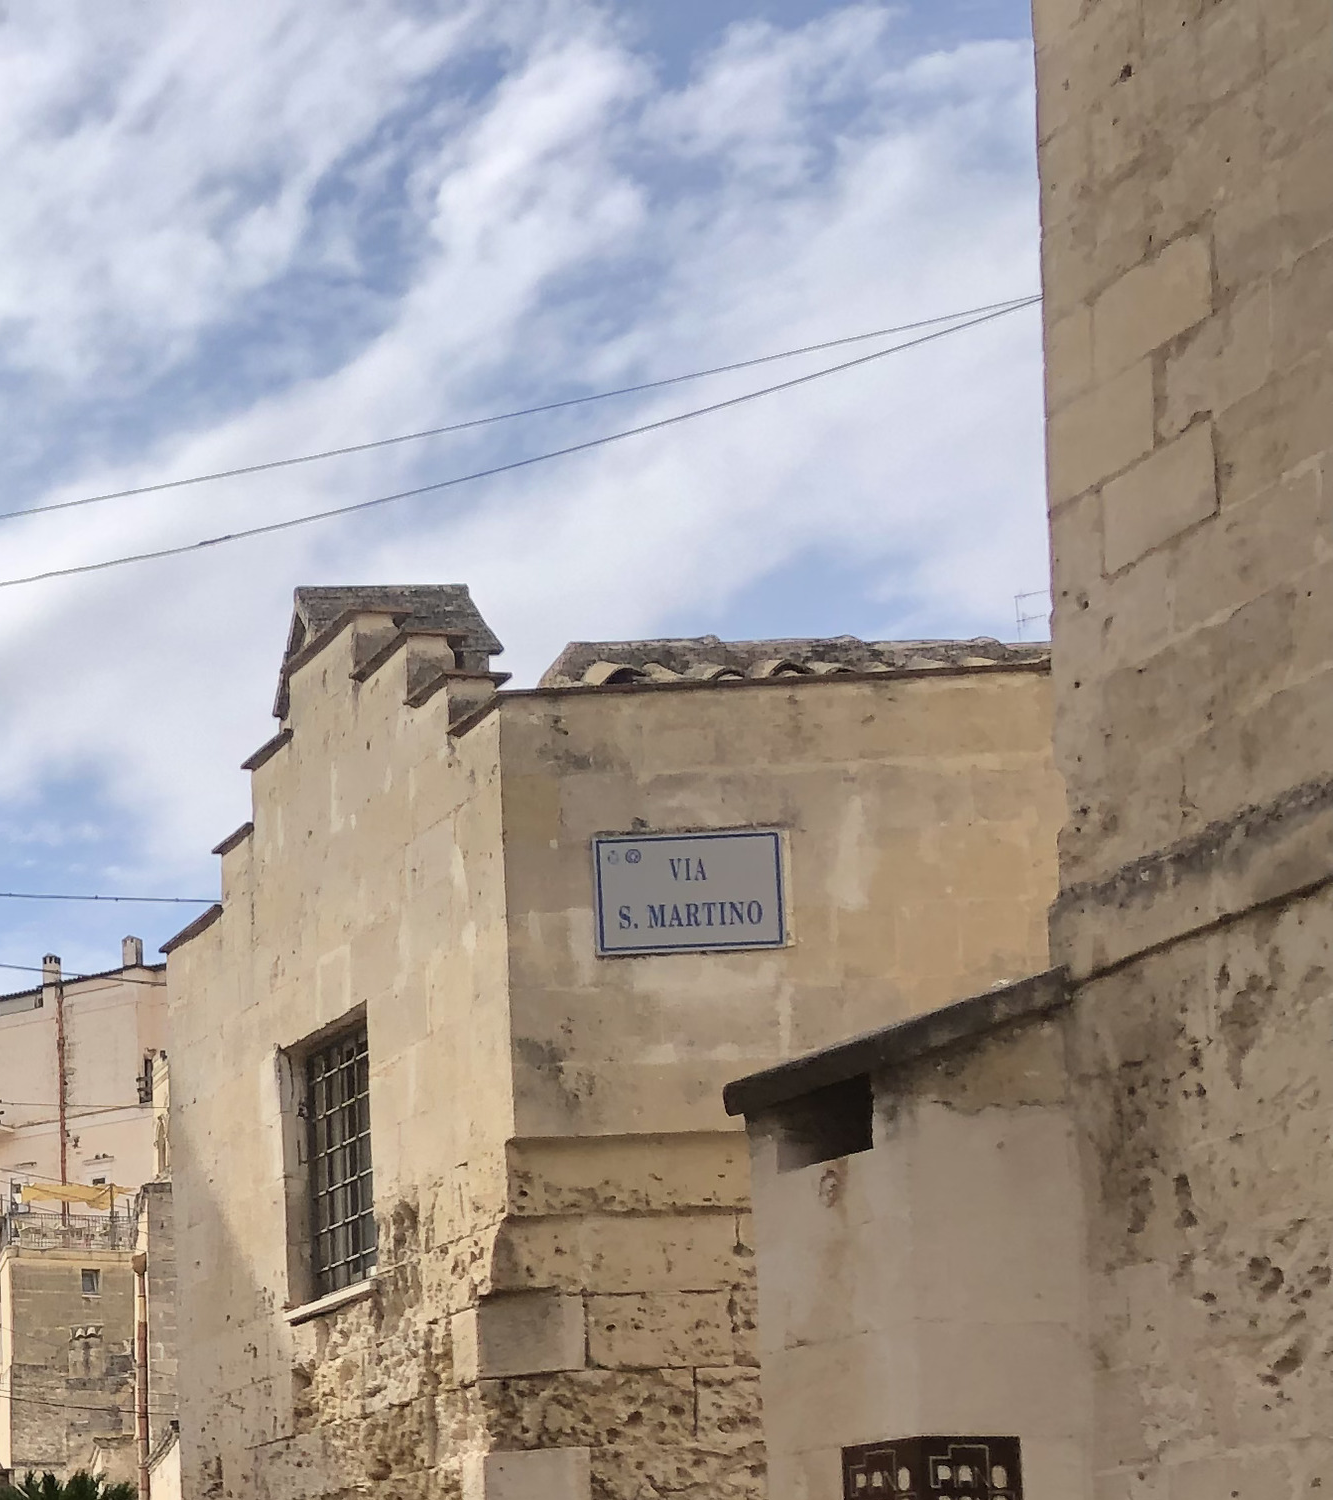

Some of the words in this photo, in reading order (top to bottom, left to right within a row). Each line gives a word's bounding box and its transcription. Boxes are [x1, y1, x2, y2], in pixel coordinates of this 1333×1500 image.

[668, 857, 708, 881] VIA
[618, 905, 638, 930] S.
[647, 900, 763, 929] MARTINO
